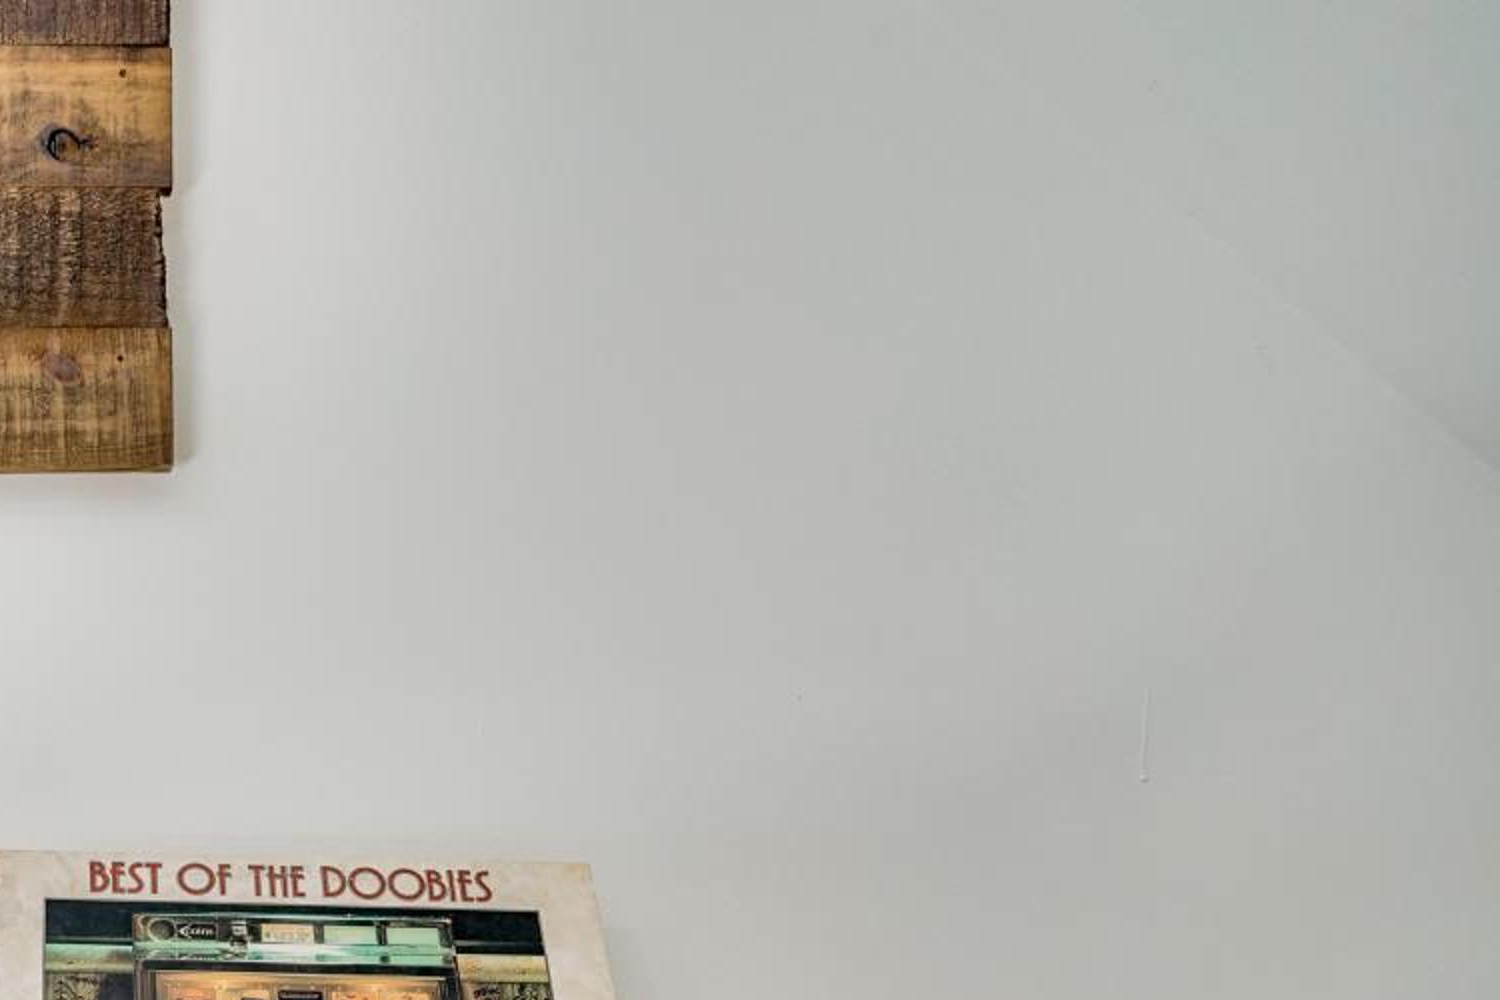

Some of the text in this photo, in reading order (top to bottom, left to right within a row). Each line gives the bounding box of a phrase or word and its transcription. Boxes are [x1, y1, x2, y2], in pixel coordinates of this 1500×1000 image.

[88, 861, 494, 903] BEST OF THE DOOBIES
